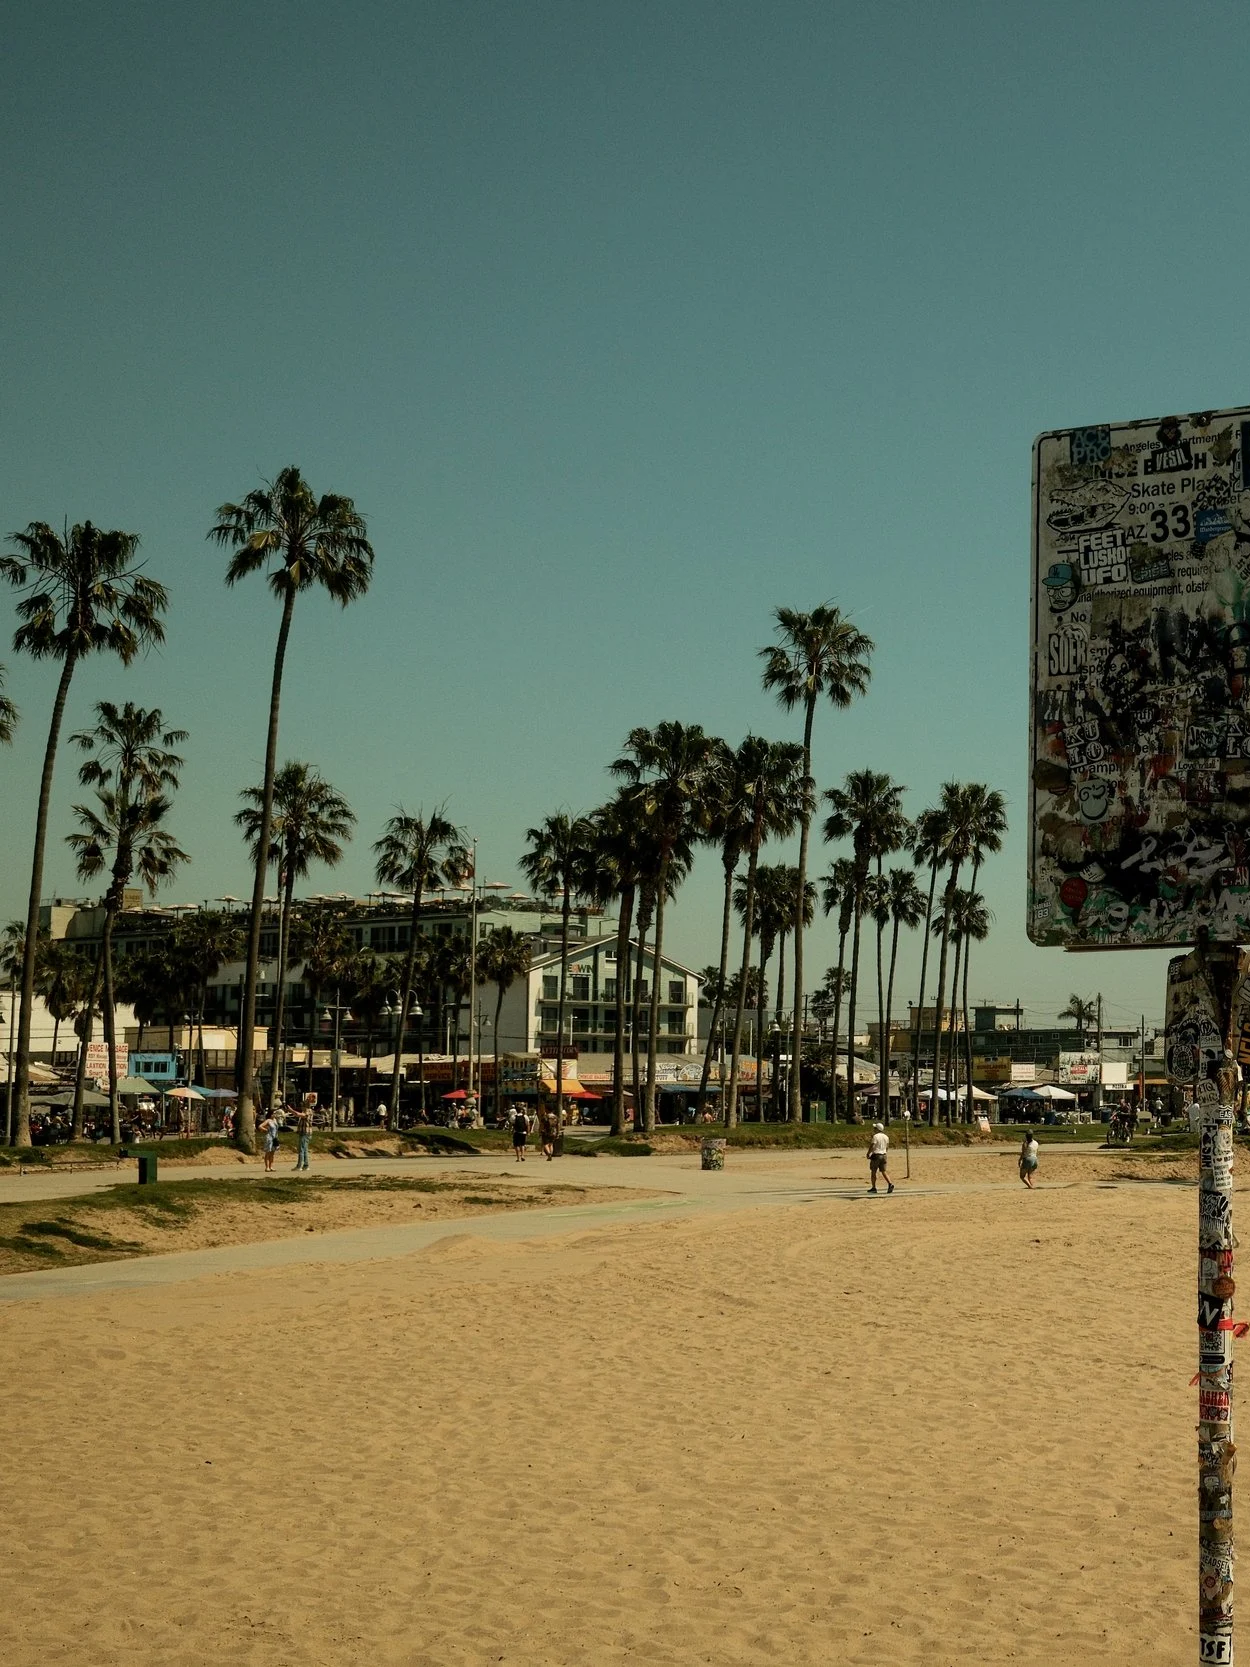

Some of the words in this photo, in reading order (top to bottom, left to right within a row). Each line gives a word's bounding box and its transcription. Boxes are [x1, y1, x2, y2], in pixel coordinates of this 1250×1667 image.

[1074, 428, 1108, 446] ACE
[1072, 443, 1111, 465] PRO
[1131, 481, 1175, 499] Skate
[1150, 504, 1190, 543] 33
[1079, 529, 1124, 552] FEET
[1081, 563, 1127, 586] UFO
[1133, 582, 1183, 598] equipment,
[1070, 611, 1087, 622] No
